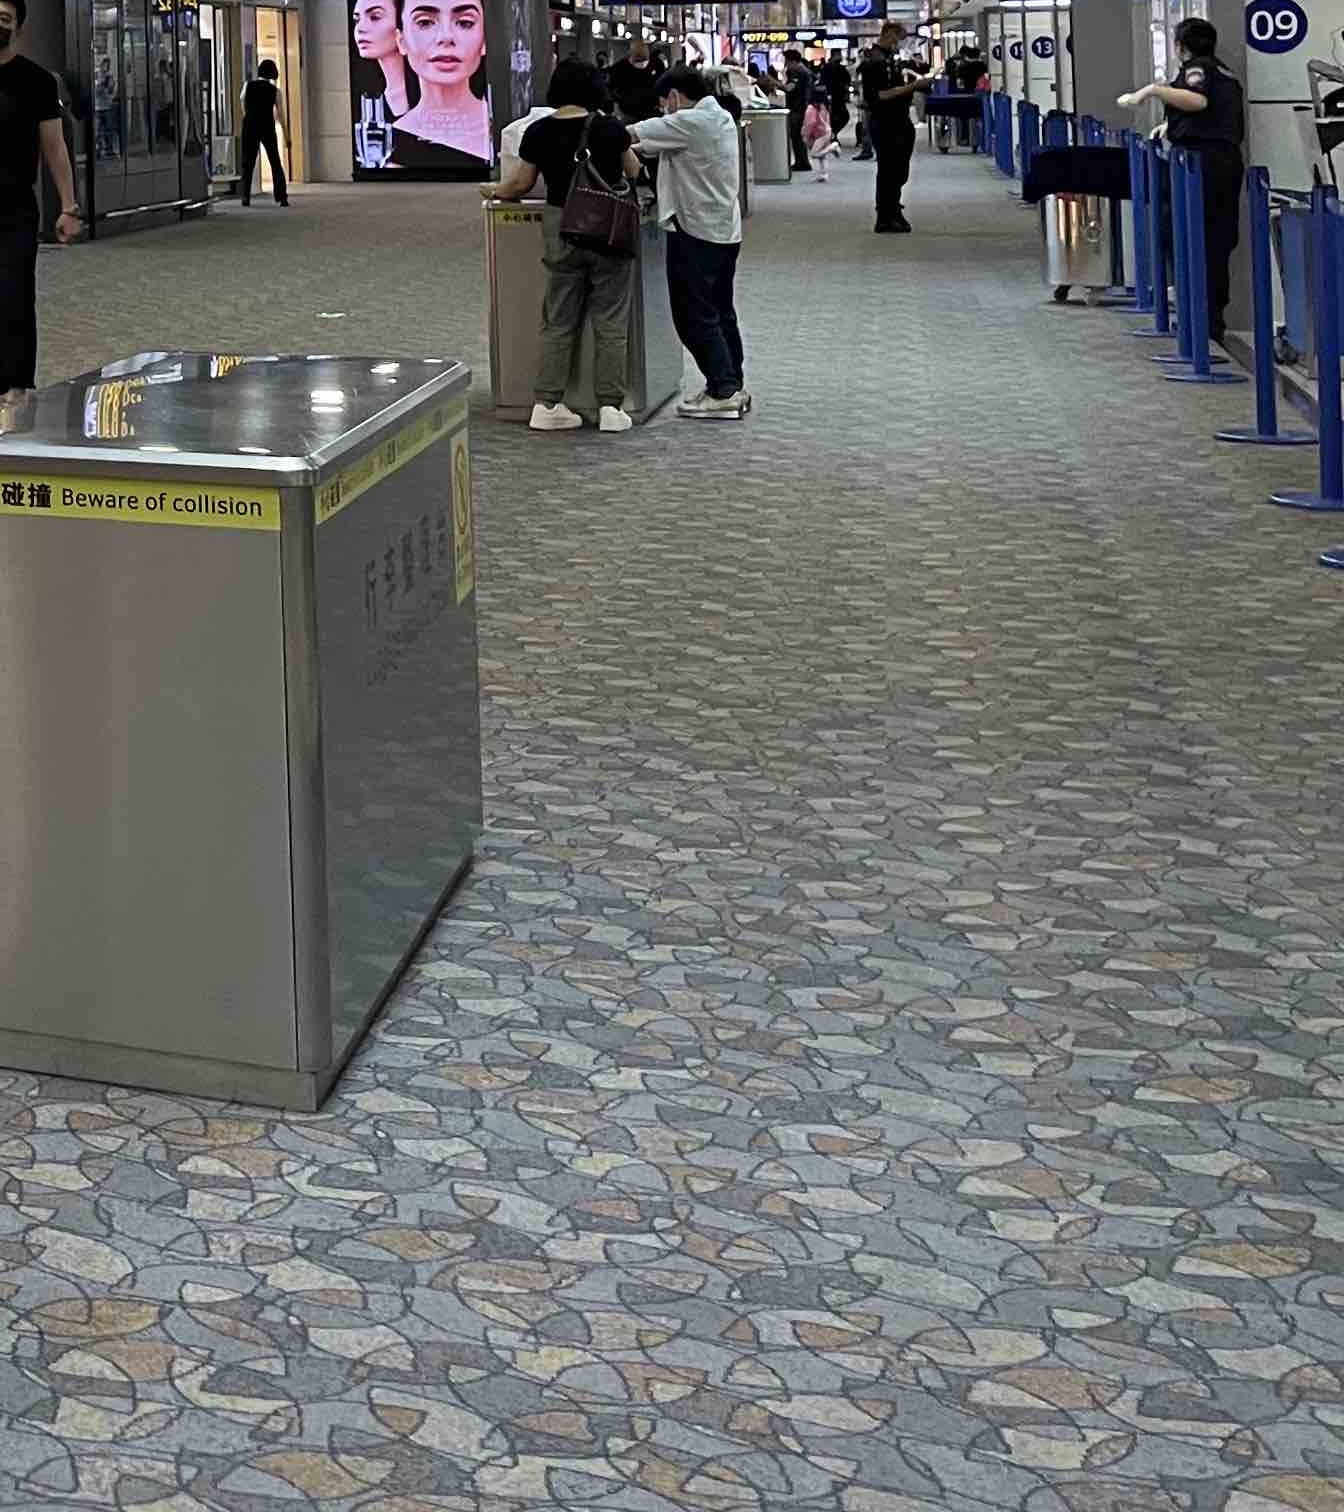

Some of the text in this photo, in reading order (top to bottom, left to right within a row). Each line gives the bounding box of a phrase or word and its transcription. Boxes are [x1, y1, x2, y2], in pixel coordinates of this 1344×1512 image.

[1250, 9, 1298, 41] 09
[1036, 41, 1052, 54] 13
[62, 488, 262, 517] Beware of collision
